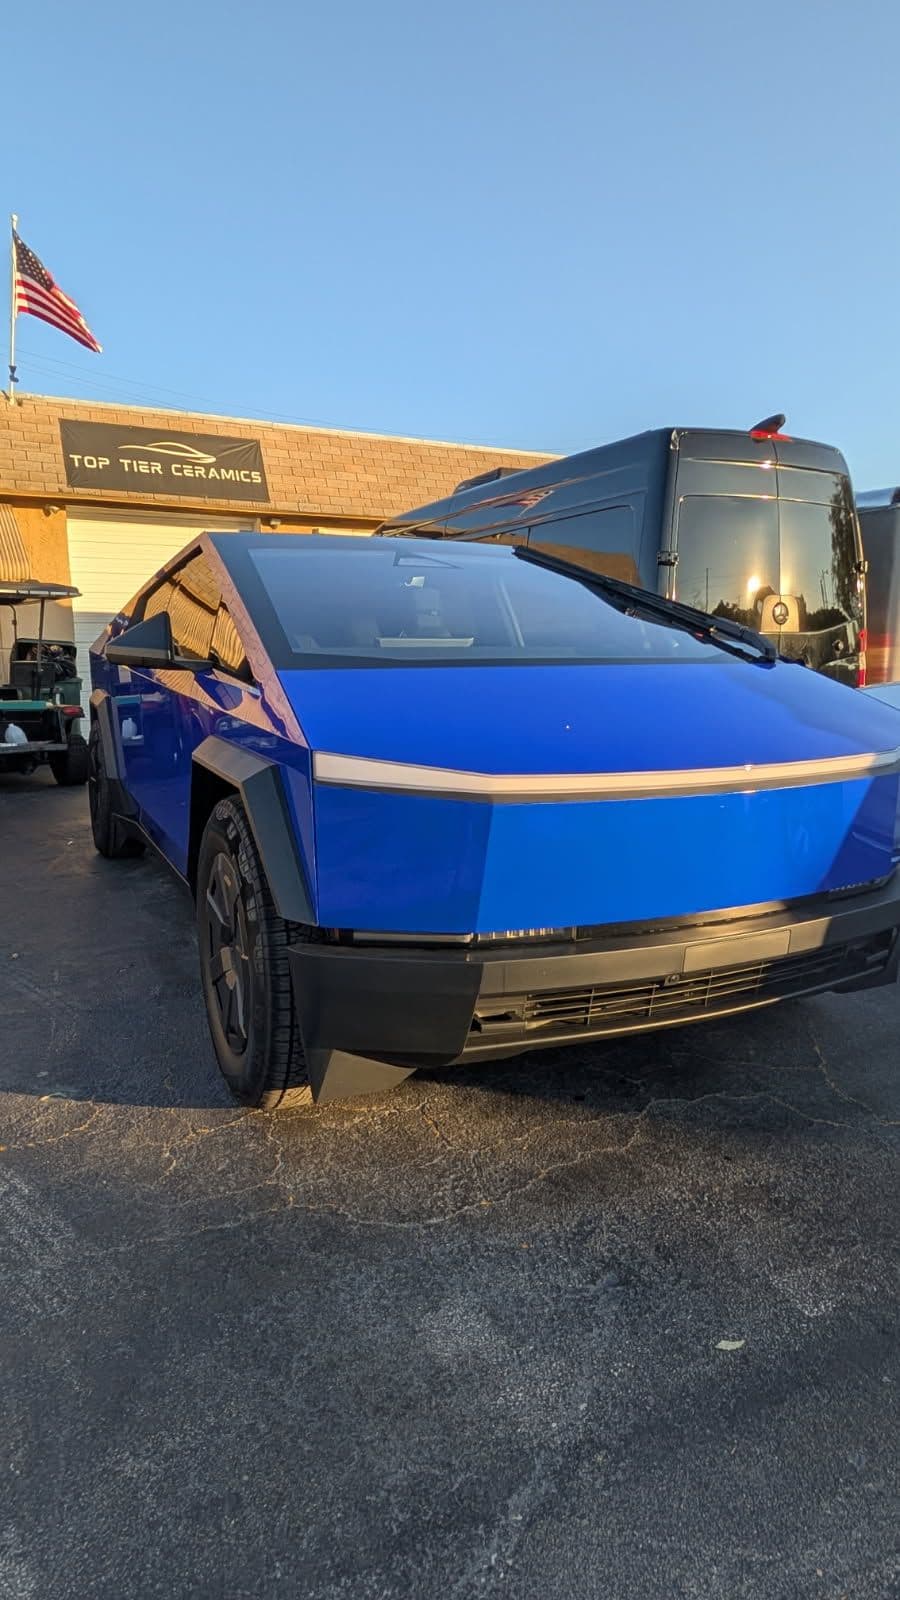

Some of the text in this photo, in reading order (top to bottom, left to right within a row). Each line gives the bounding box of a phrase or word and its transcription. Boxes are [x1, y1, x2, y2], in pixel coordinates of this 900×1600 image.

[69, 454, 262, 484] TOP TIER CERAMICS
